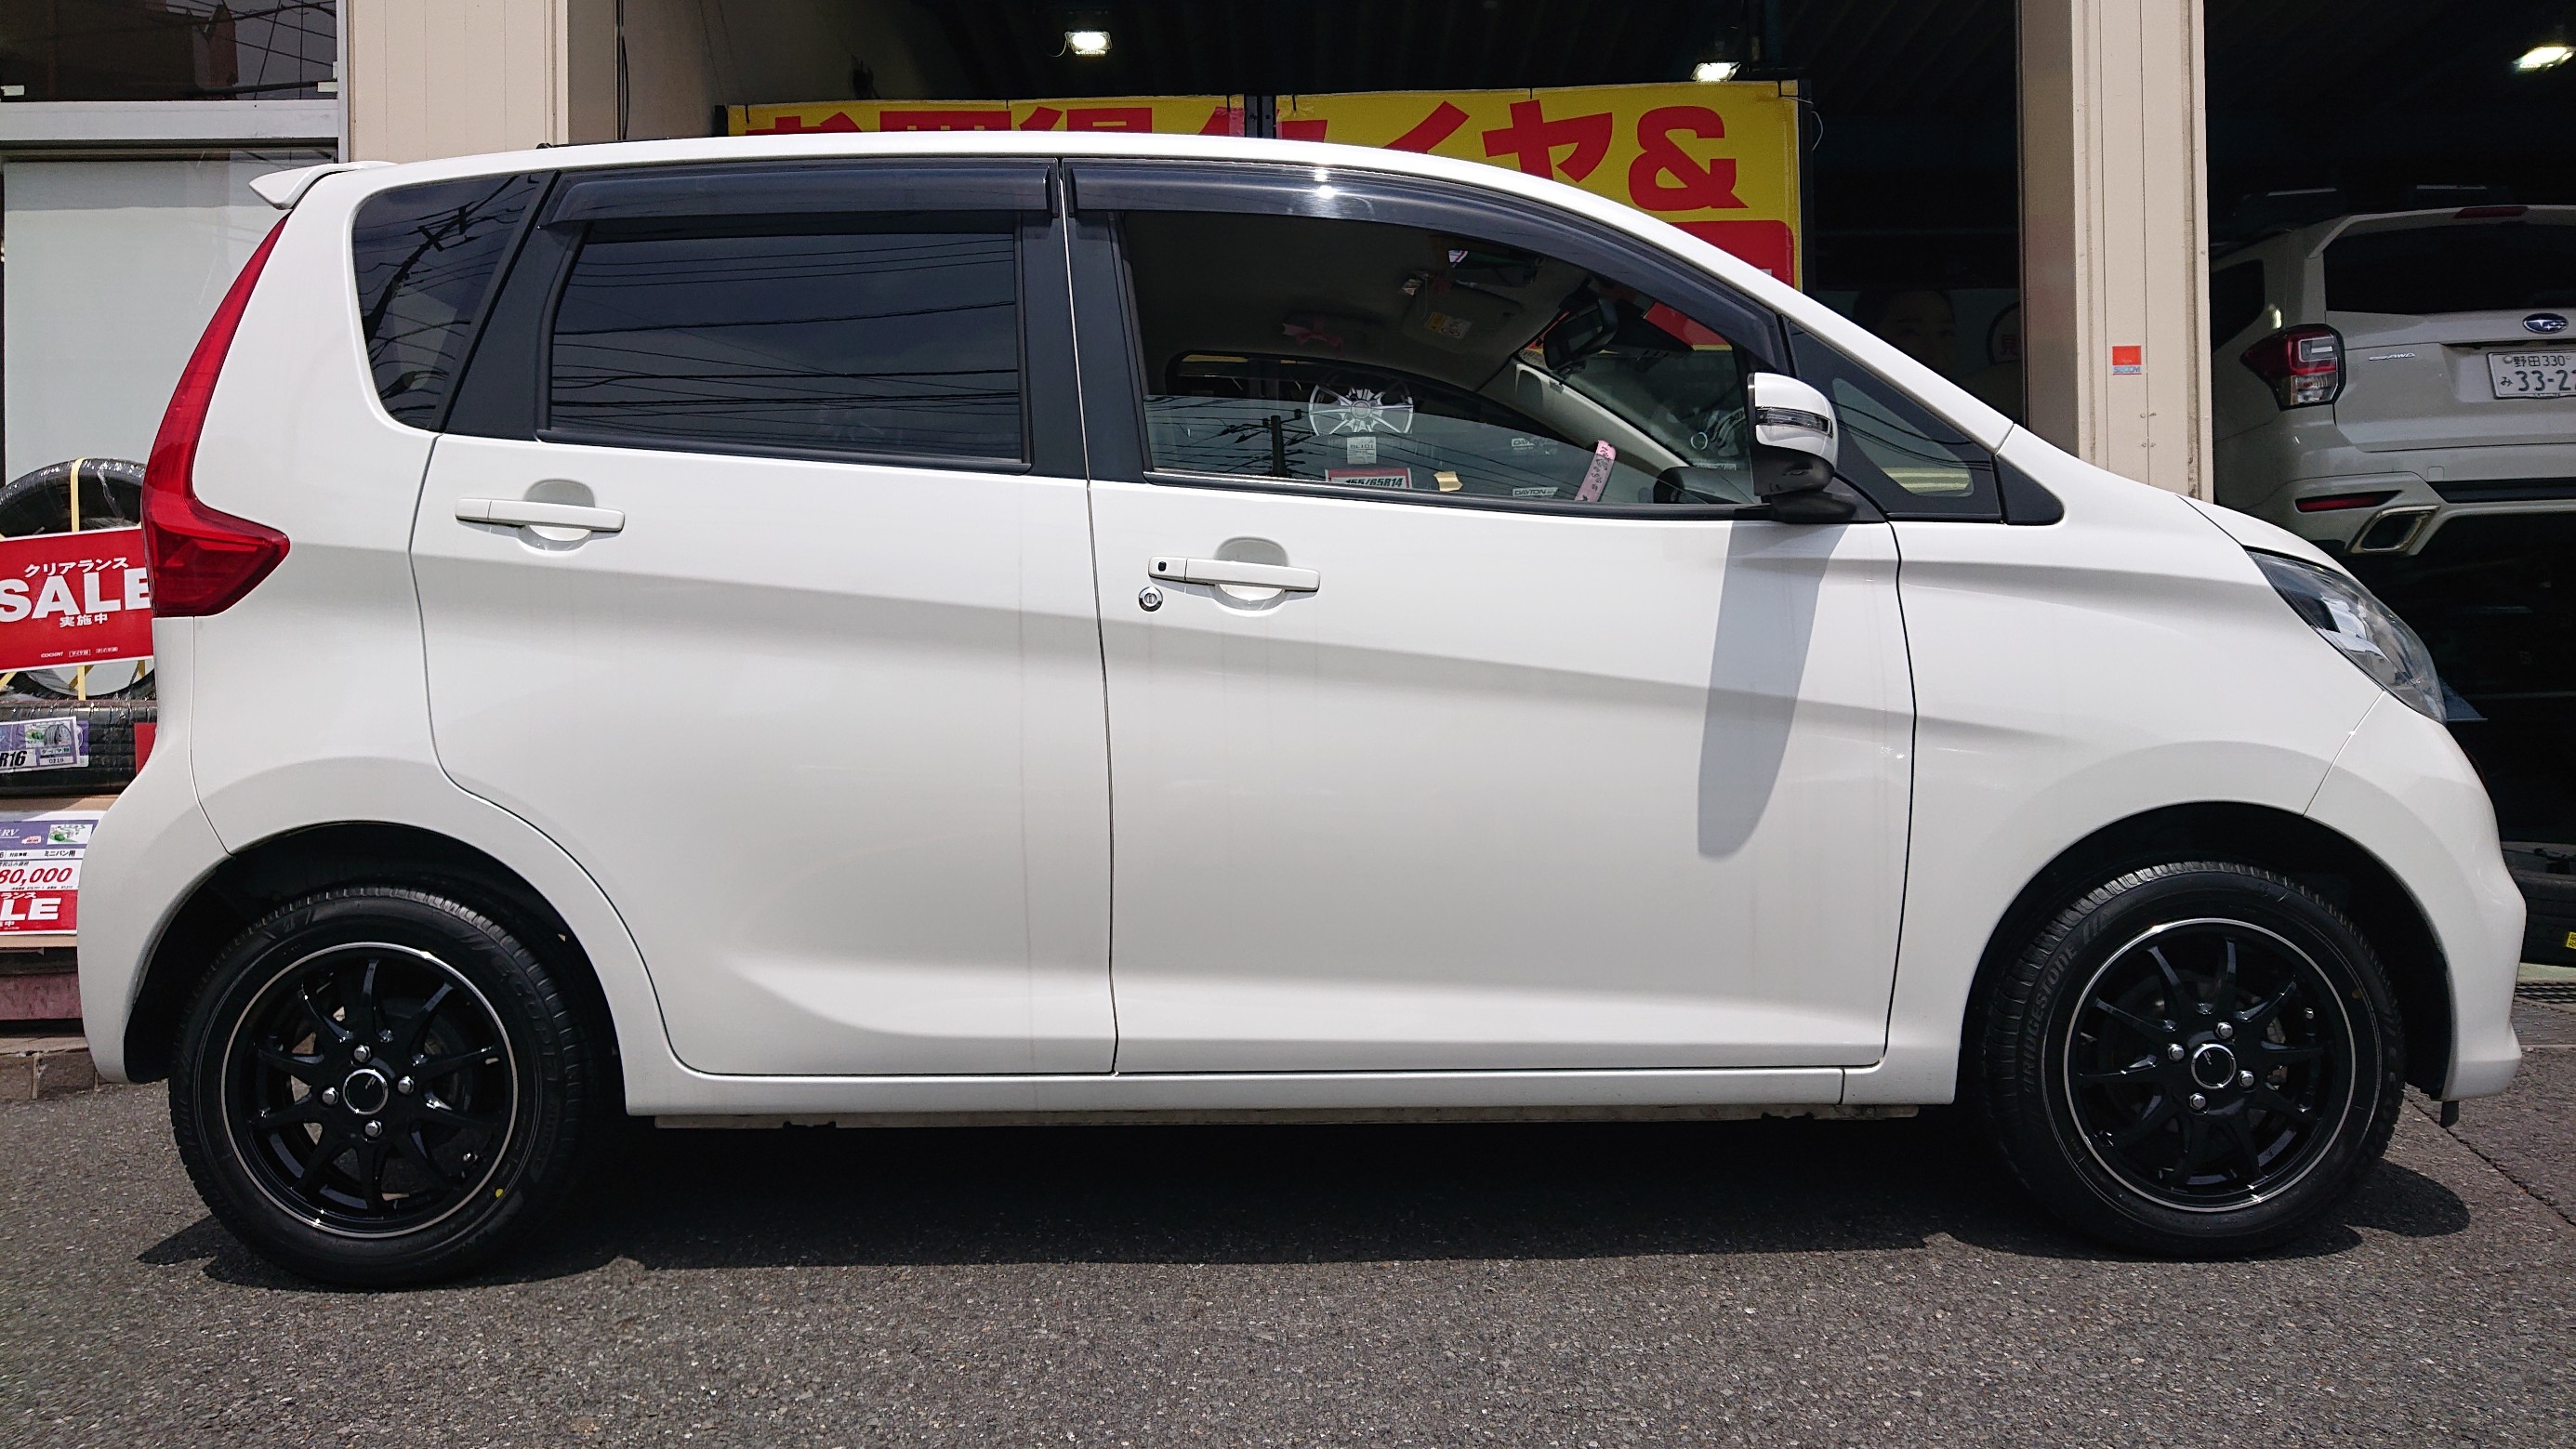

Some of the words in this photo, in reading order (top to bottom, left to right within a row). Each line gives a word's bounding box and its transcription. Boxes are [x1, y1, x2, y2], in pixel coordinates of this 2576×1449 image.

[2500, 376, 2514, 388] み
[24, 557, 129, 578] クリアランス
[0, 567, 151, 623] SALE
[59, 613, 109, 628] 実施中
